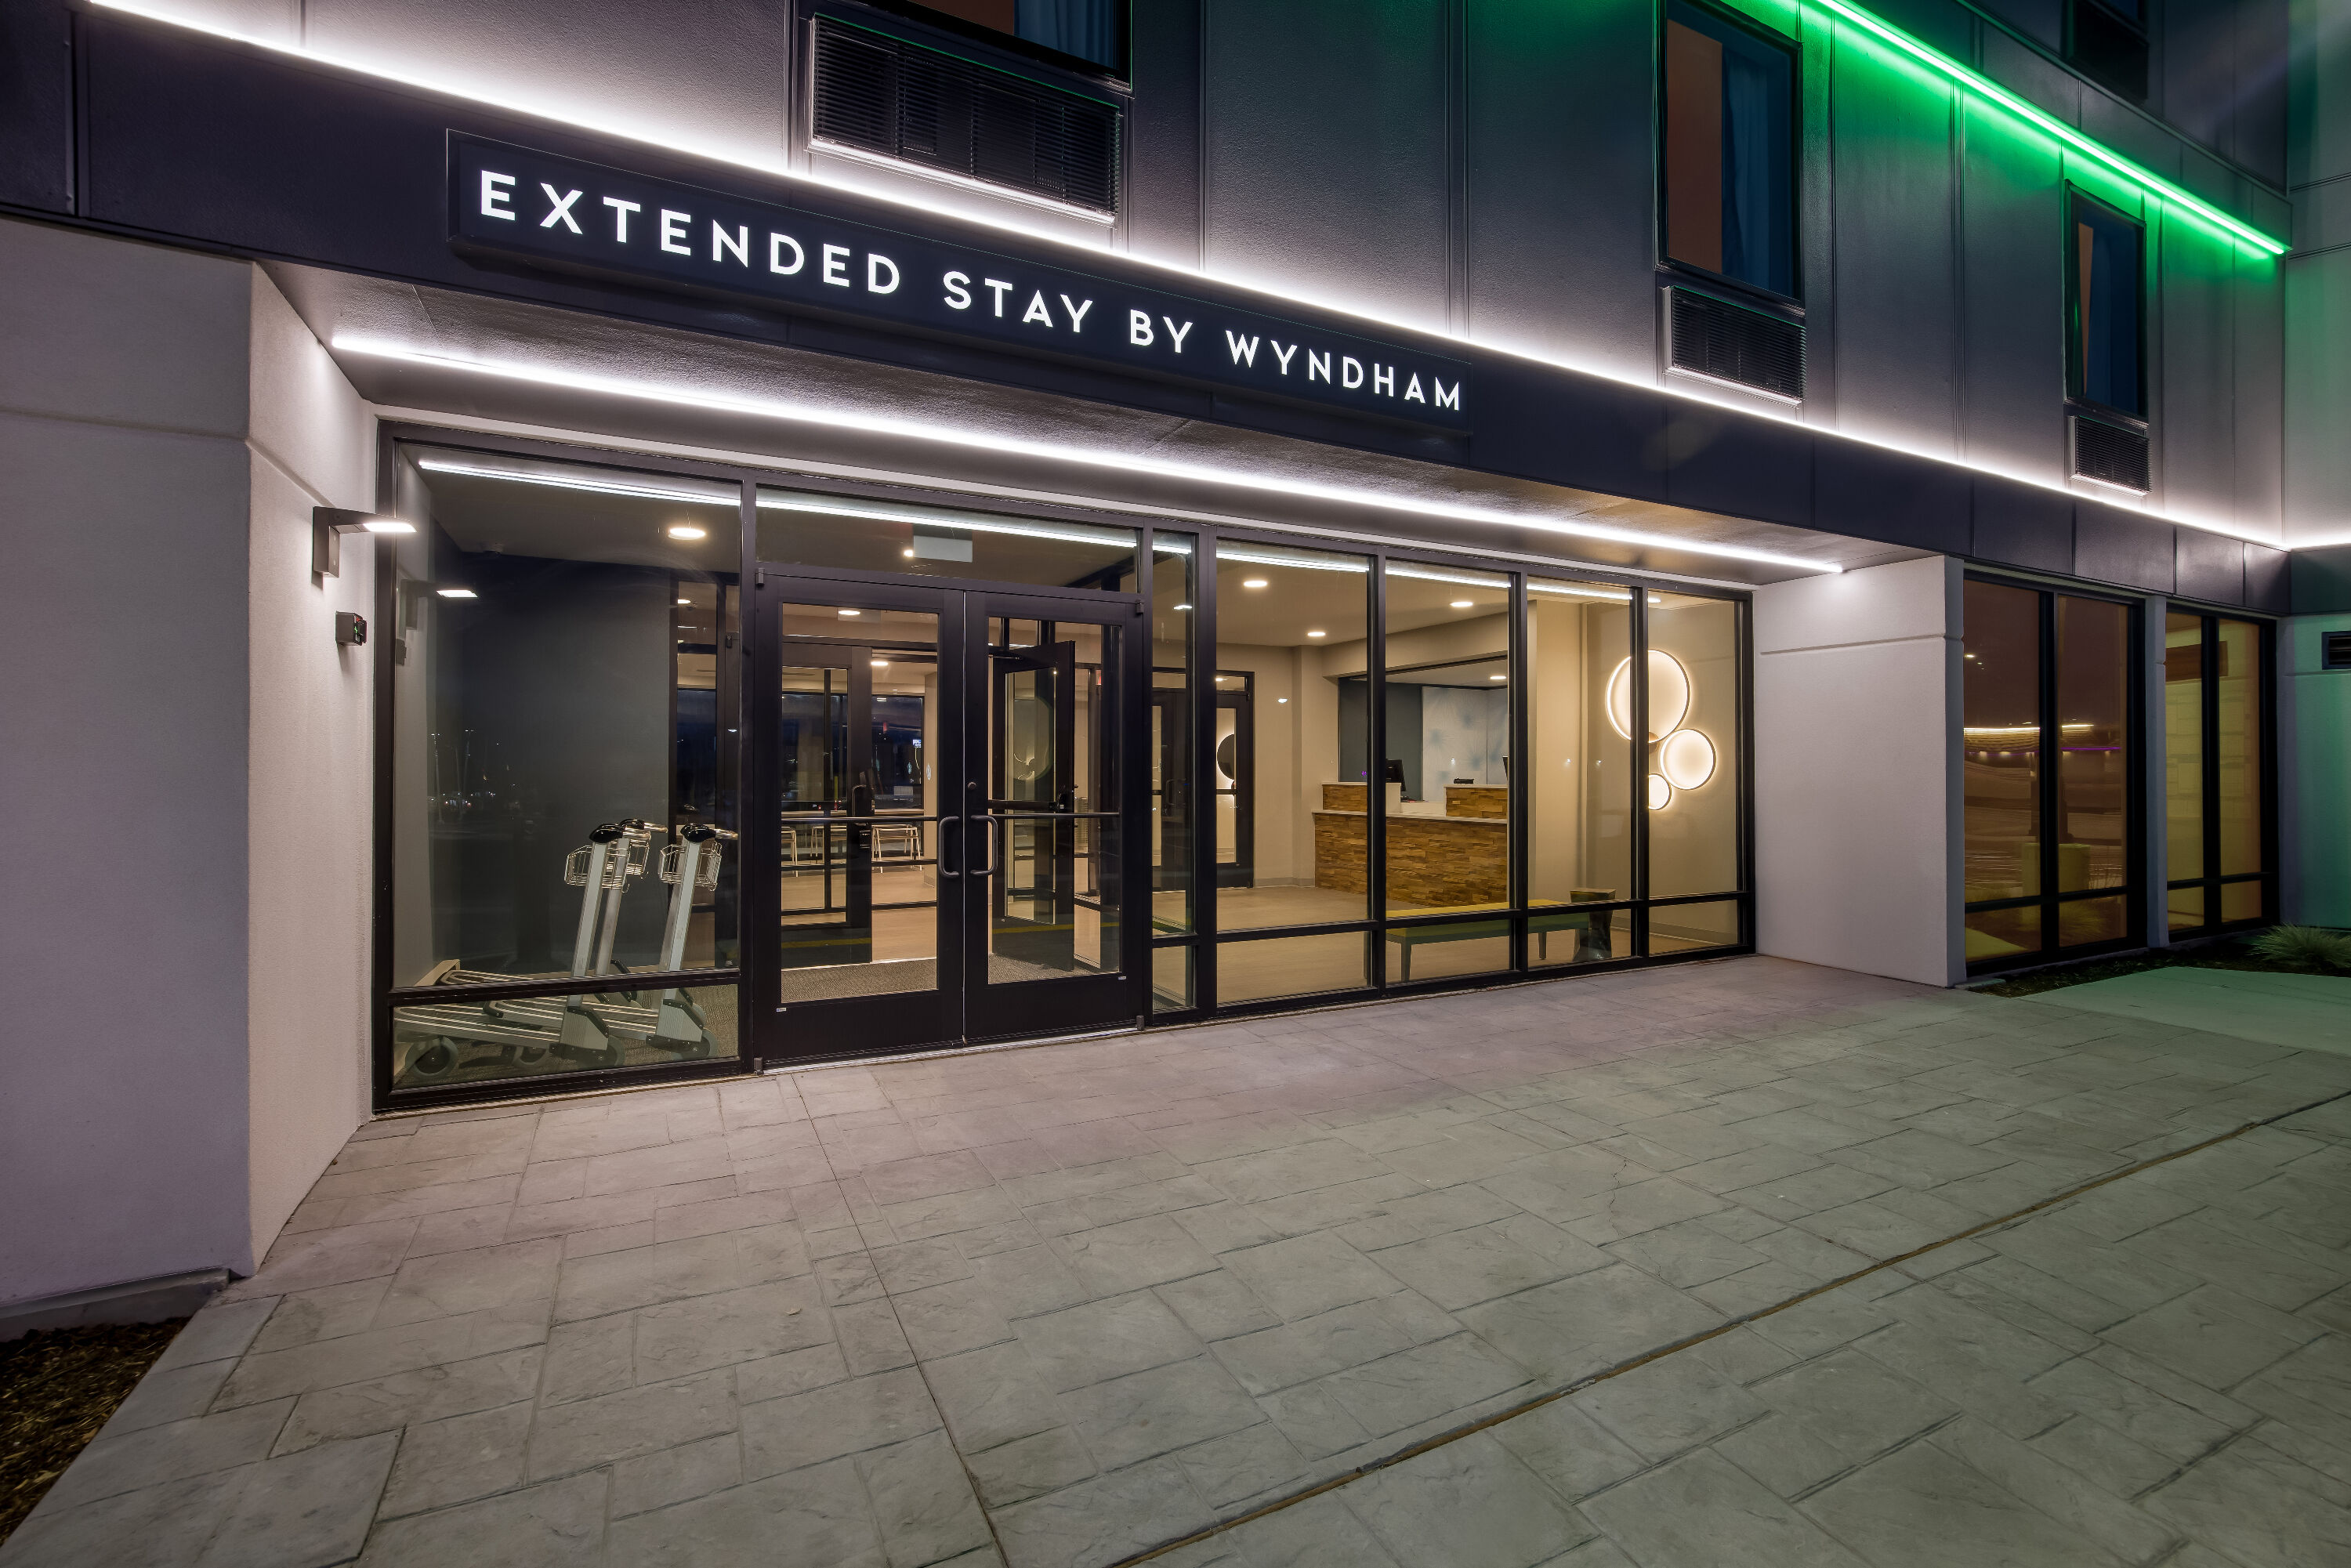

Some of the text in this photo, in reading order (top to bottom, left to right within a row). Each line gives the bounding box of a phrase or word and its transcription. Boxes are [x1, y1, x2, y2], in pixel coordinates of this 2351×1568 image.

[480, 169, 1461, 411] EXTENDED STAY BY WYNDHAM
